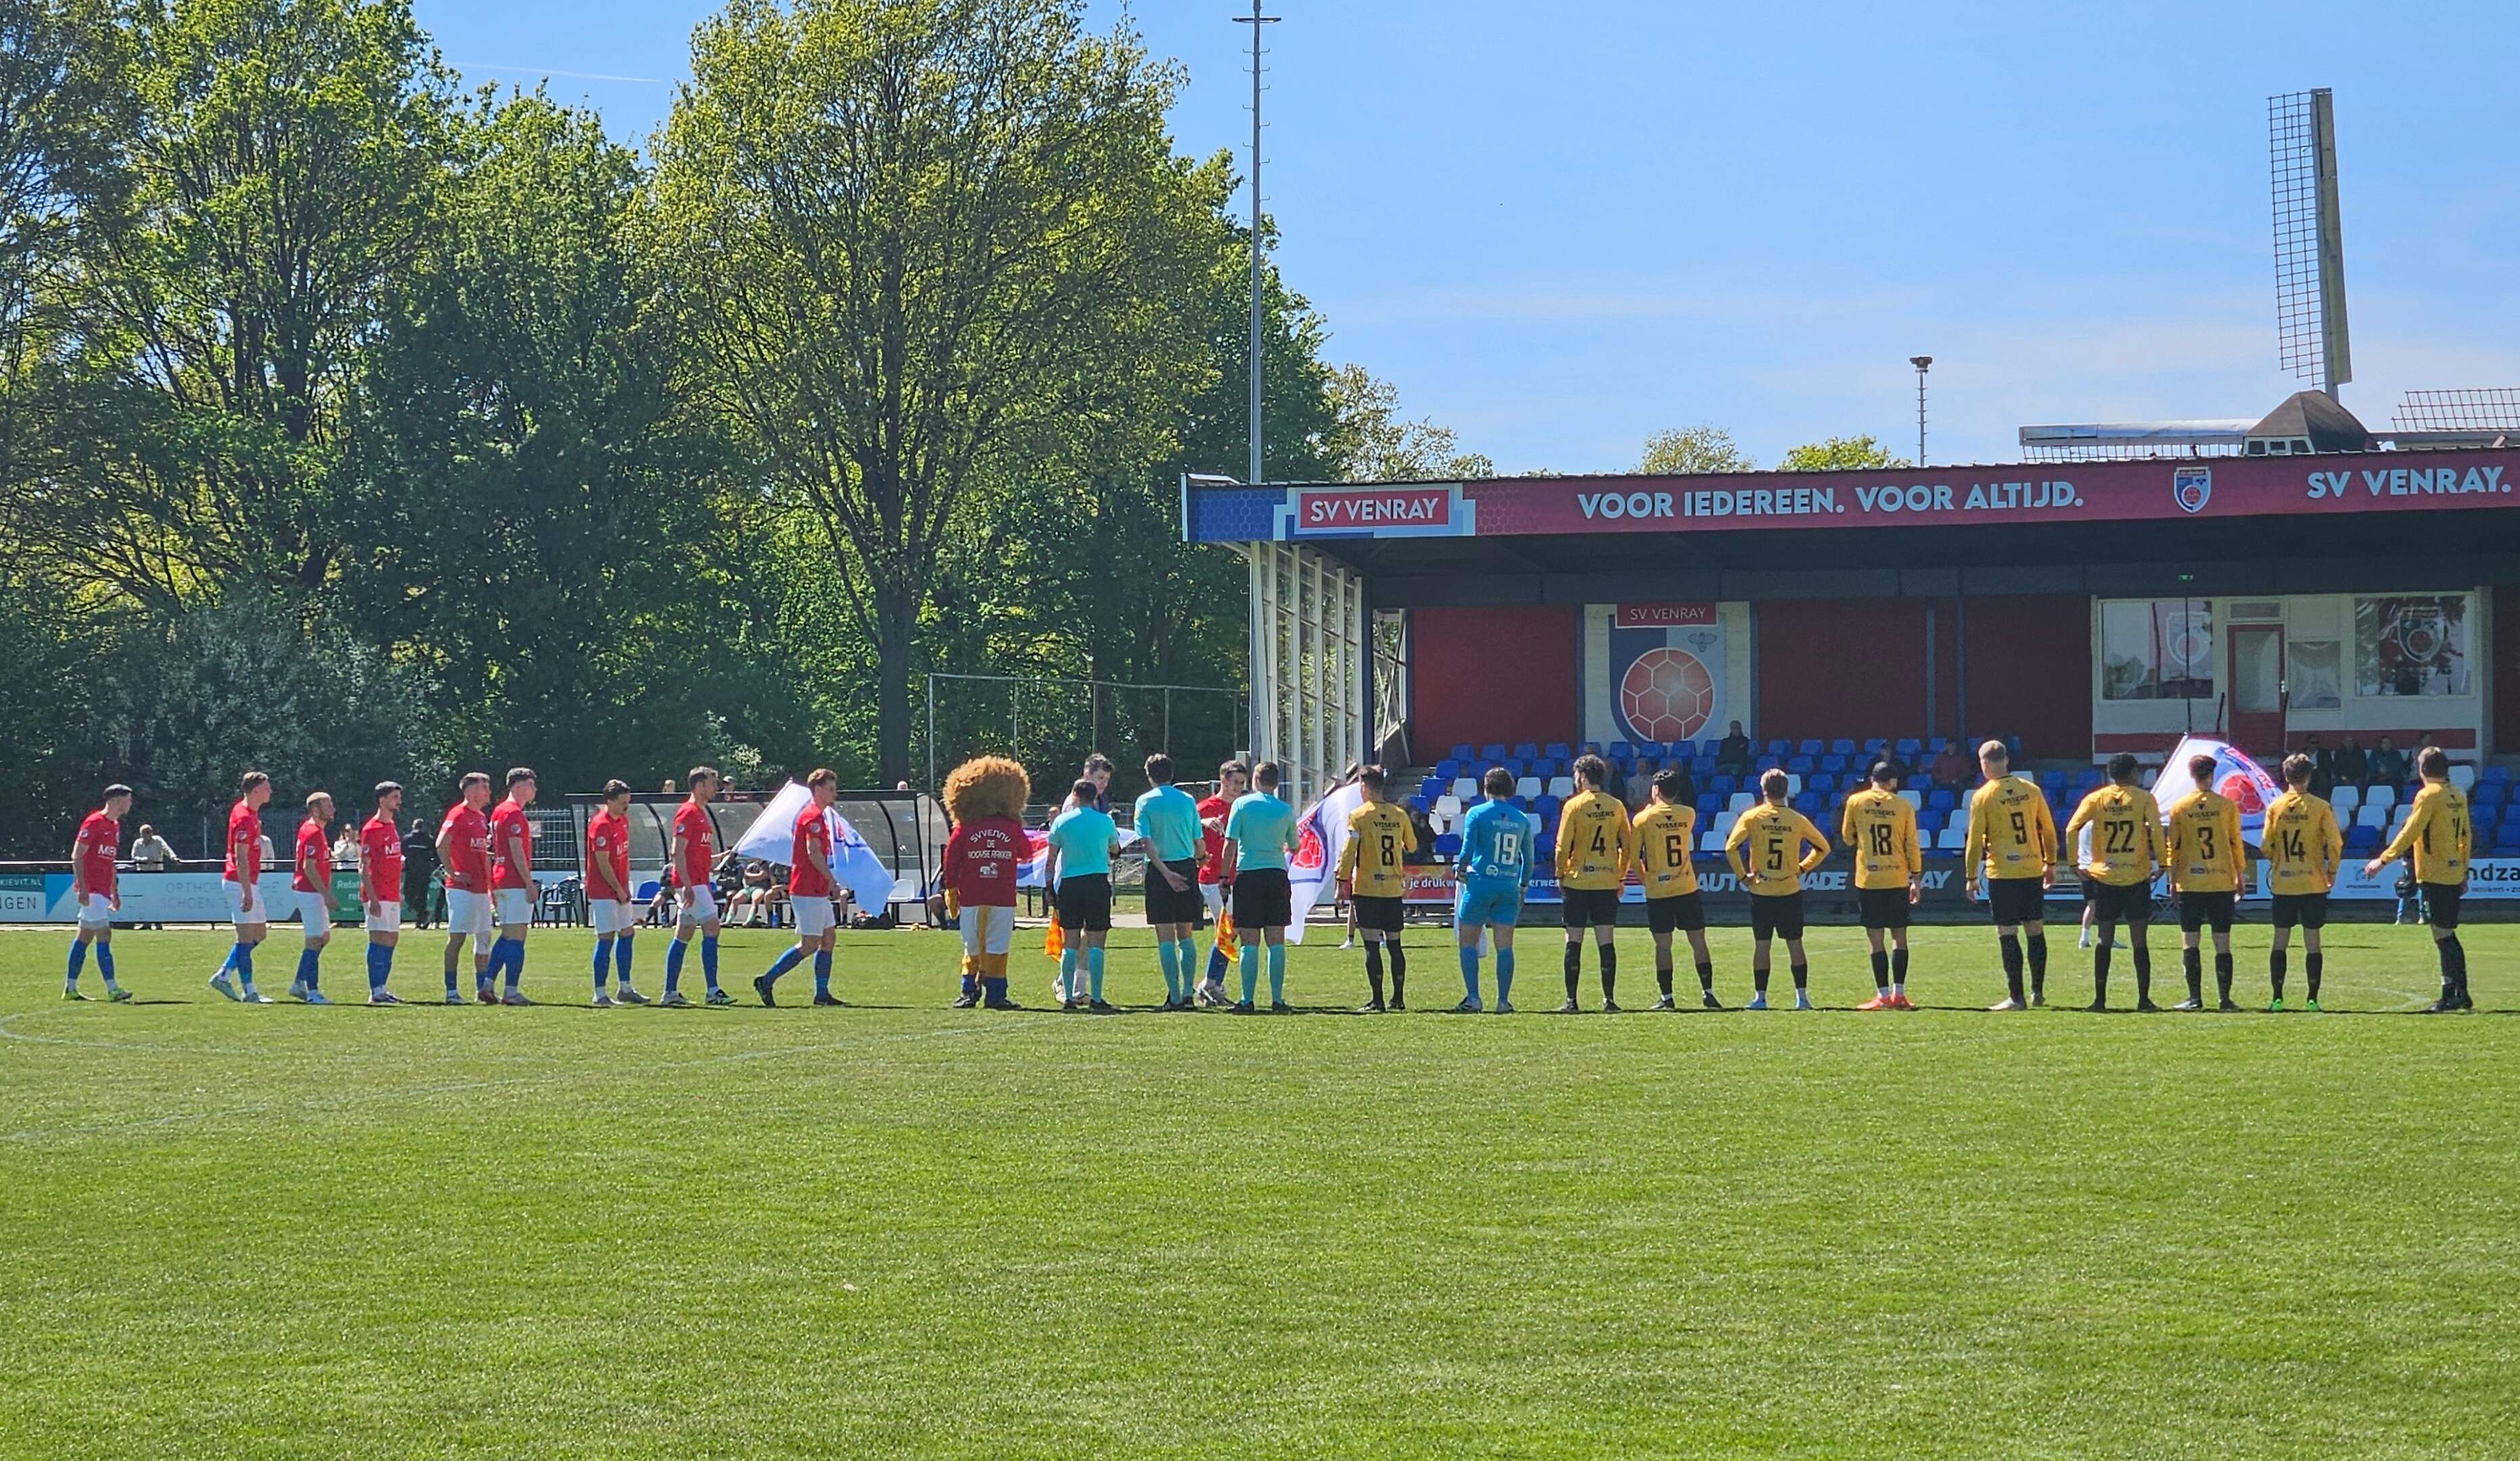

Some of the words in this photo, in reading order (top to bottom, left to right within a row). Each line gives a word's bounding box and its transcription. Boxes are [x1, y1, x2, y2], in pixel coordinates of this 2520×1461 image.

[2307, 471, 2351, 499] SV
[2361, 466, 2512, 496] VENRAY.
[1311, 500, 1341, 523] SV
[1345, 497, 1439, 521] VENRAY
[1577, 492, 1674, 519] VOOR
[1685, 487, 1845, 517] IEDEREEN.
[1855, 484, 1955, 512] VOOR
[1963, 481, 2084, 509] ALTIJD.
[1630, 608, 1648, 620] SV
[1652, 607, 1706, 620] VENRAY
[1591, 825, 1606, 857] 4
[1869, 823, 1892, 856] 18
[2009, 811, 2028, 845] 9
[2103, 820, 2134, 854] 22
[2197, 827, 2215, 860] 3
[1381, 835, 1395, 866] 8
[1493, 832, 1518, 866] 19
[1665, 834, 1683, 868] 6
[1767, 838, 1783, 871] 5
[2282, 829, 2306, 863] 14
[337, 879, 361, 889] Relat
[1408, 878, 1420, 891] je
[1421, 877, 1455, 888] drukw
[2467, 862, 2520, 881] ndza
[0, 897, 37, 910] GEN
